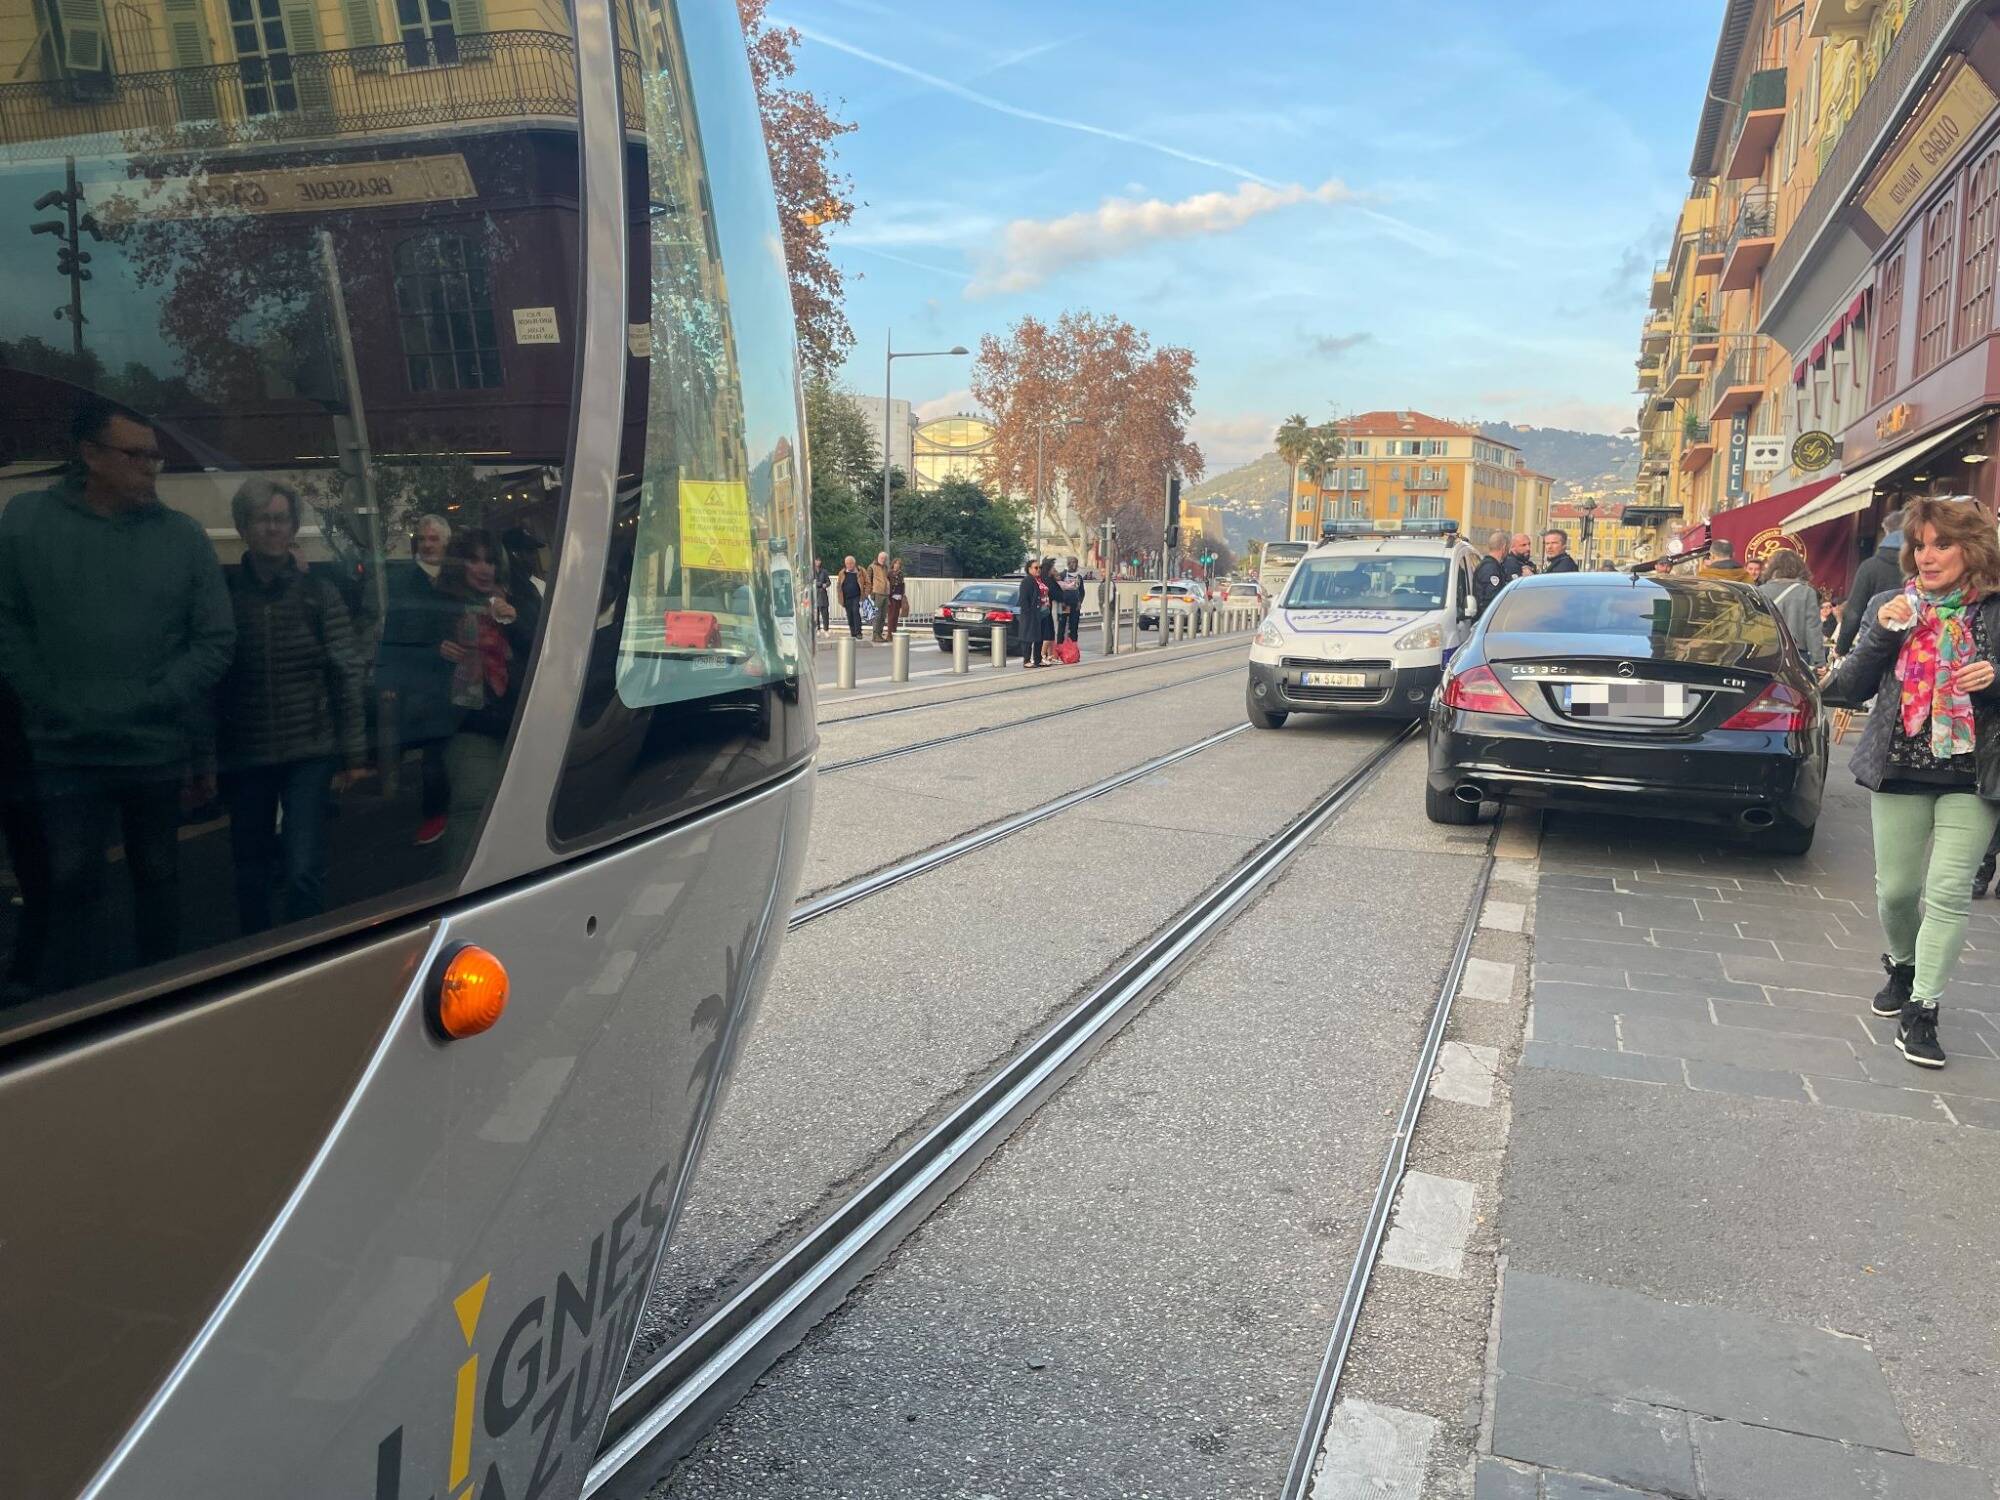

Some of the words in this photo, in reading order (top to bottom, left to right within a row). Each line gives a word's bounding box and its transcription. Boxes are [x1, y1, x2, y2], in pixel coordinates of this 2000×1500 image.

[1919, 114, 1960, 167] GAGLIO
[1730, 418, 1745, 491] HOTEL
[1293, 614, 1408, 622] NATIONALE
[1511, 666, 1536, 674] CLS
[1723, 678, 1746, 688] CDI
